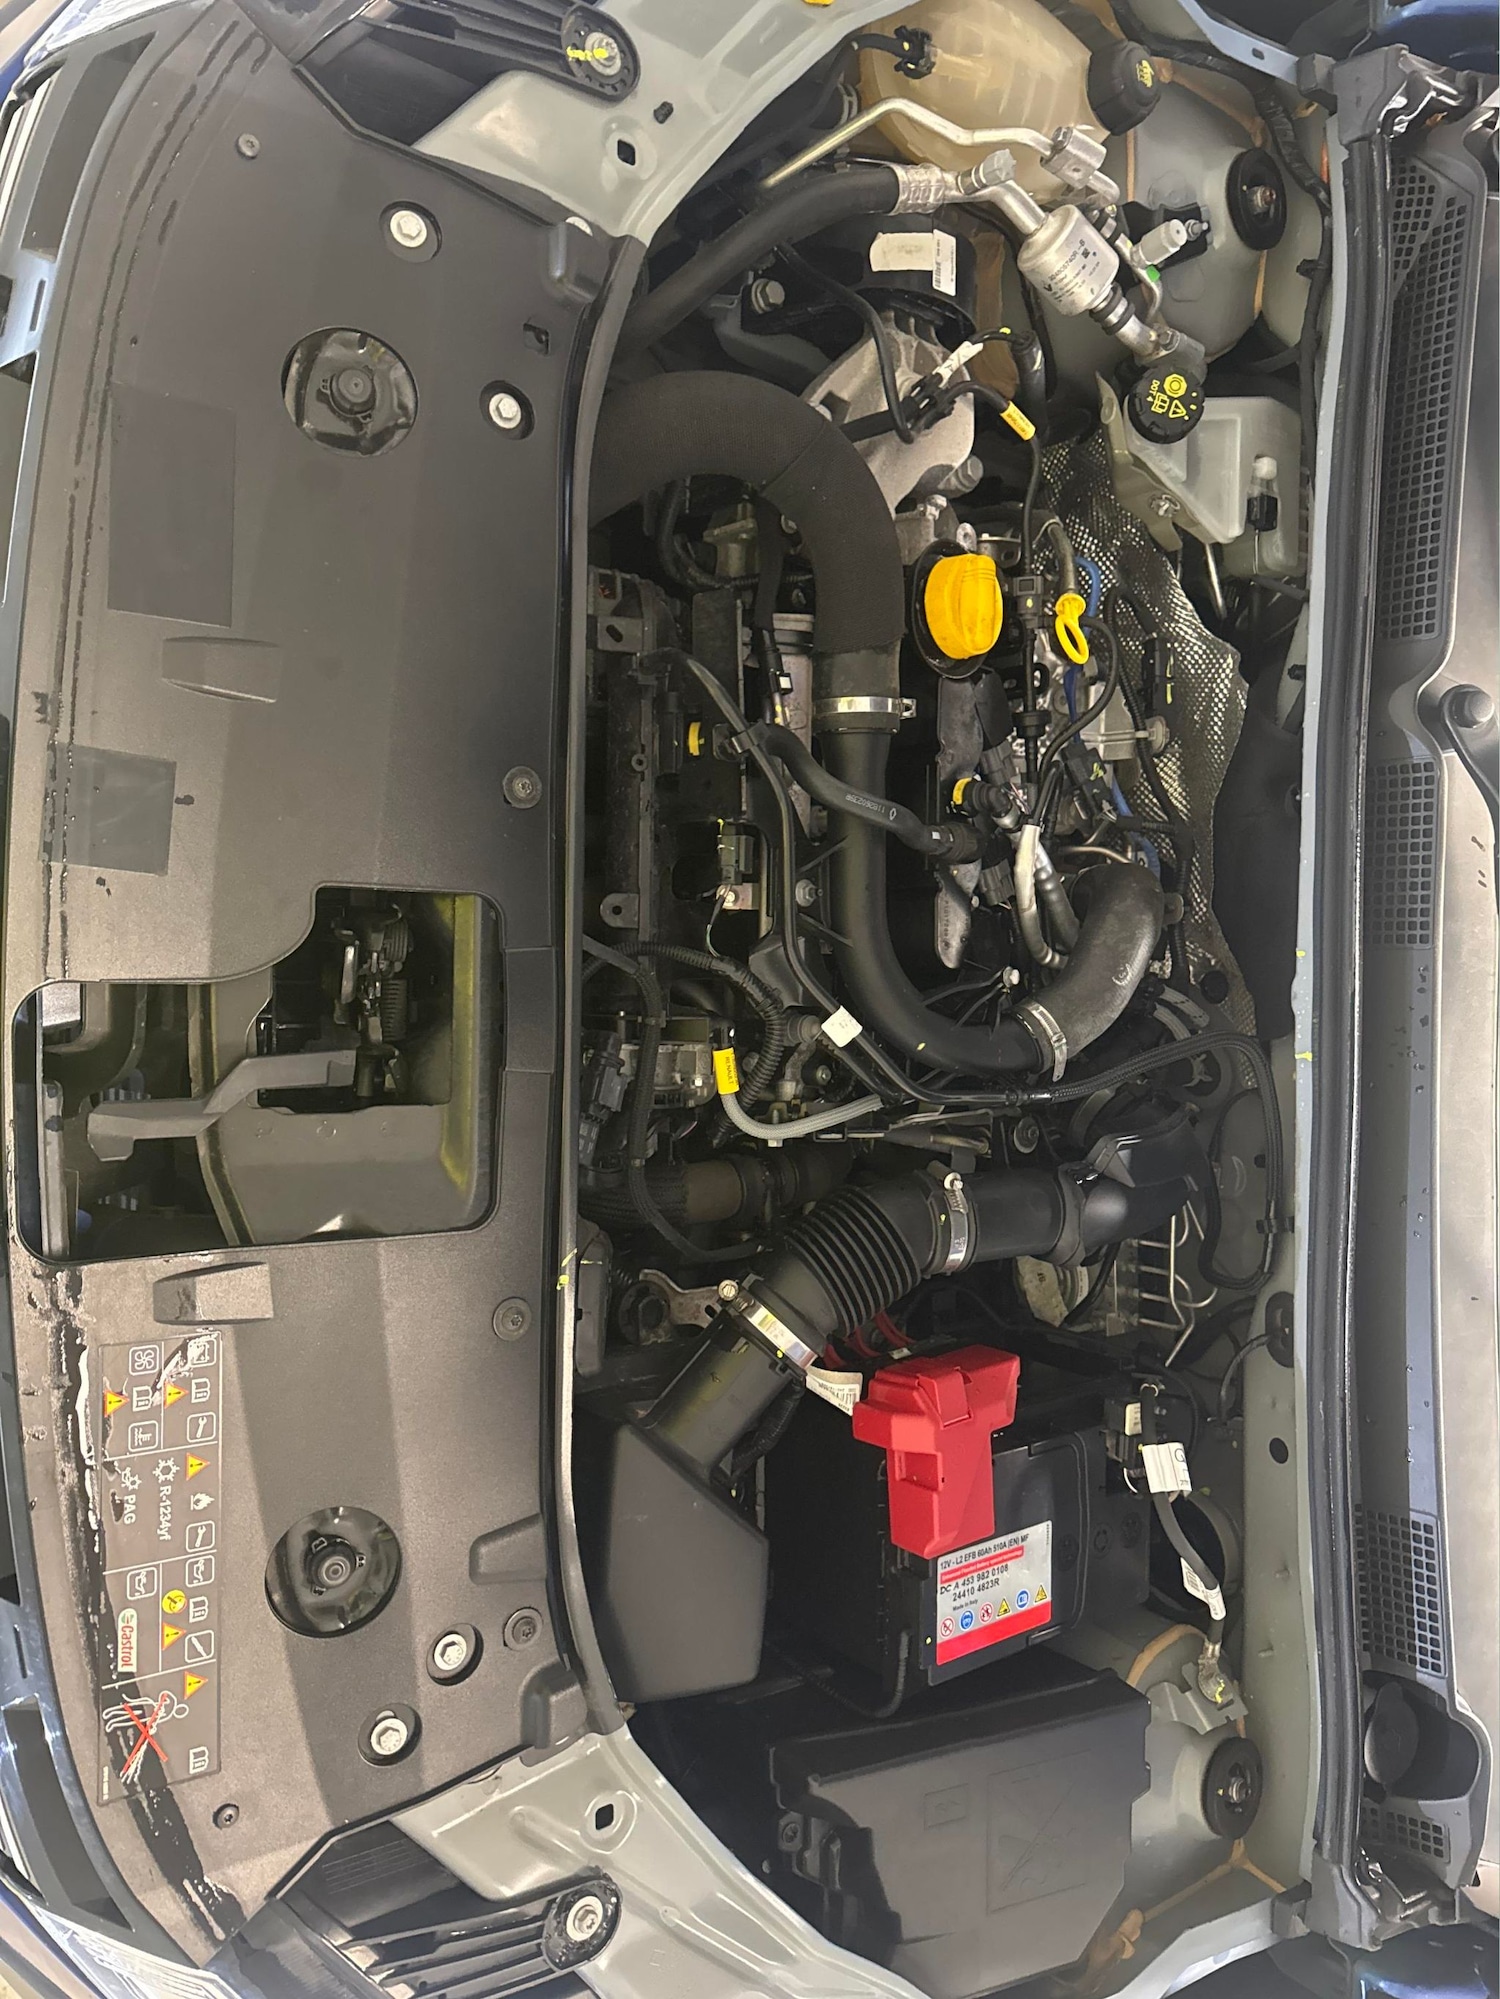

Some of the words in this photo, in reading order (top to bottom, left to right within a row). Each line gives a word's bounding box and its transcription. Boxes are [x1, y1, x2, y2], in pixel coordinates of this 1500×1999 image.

[1149, 379, 1160, 396] DOT
[725, 1056, 734, 1084] RENAULT
[123, 1494, 136, 1525] PAG
[157, 1485, 172, 1541] R-1234yf
[940, 1559, 951, 1570] 12V
[955, 1555, 963, 1565] L2
[964, 1550, 976, 1562] EFB
[977, 1545, 992, 1557] 60Ah
[1007, 1537, 1019, 1549] (EN)
[1020, 1533, 1029, 1543] MF
[952, 1588, 975, 1602] 24410
[976, 1577, 1000, 1592] 4823R
[953, 1582, 959, 1591] A
[961, 1576, 975, 1587] 453
[976, 1571, 990, 1583] 982
[991, 1564, 1009, 1577] 0108
[121, 1625, 134, 1668] Castrol
